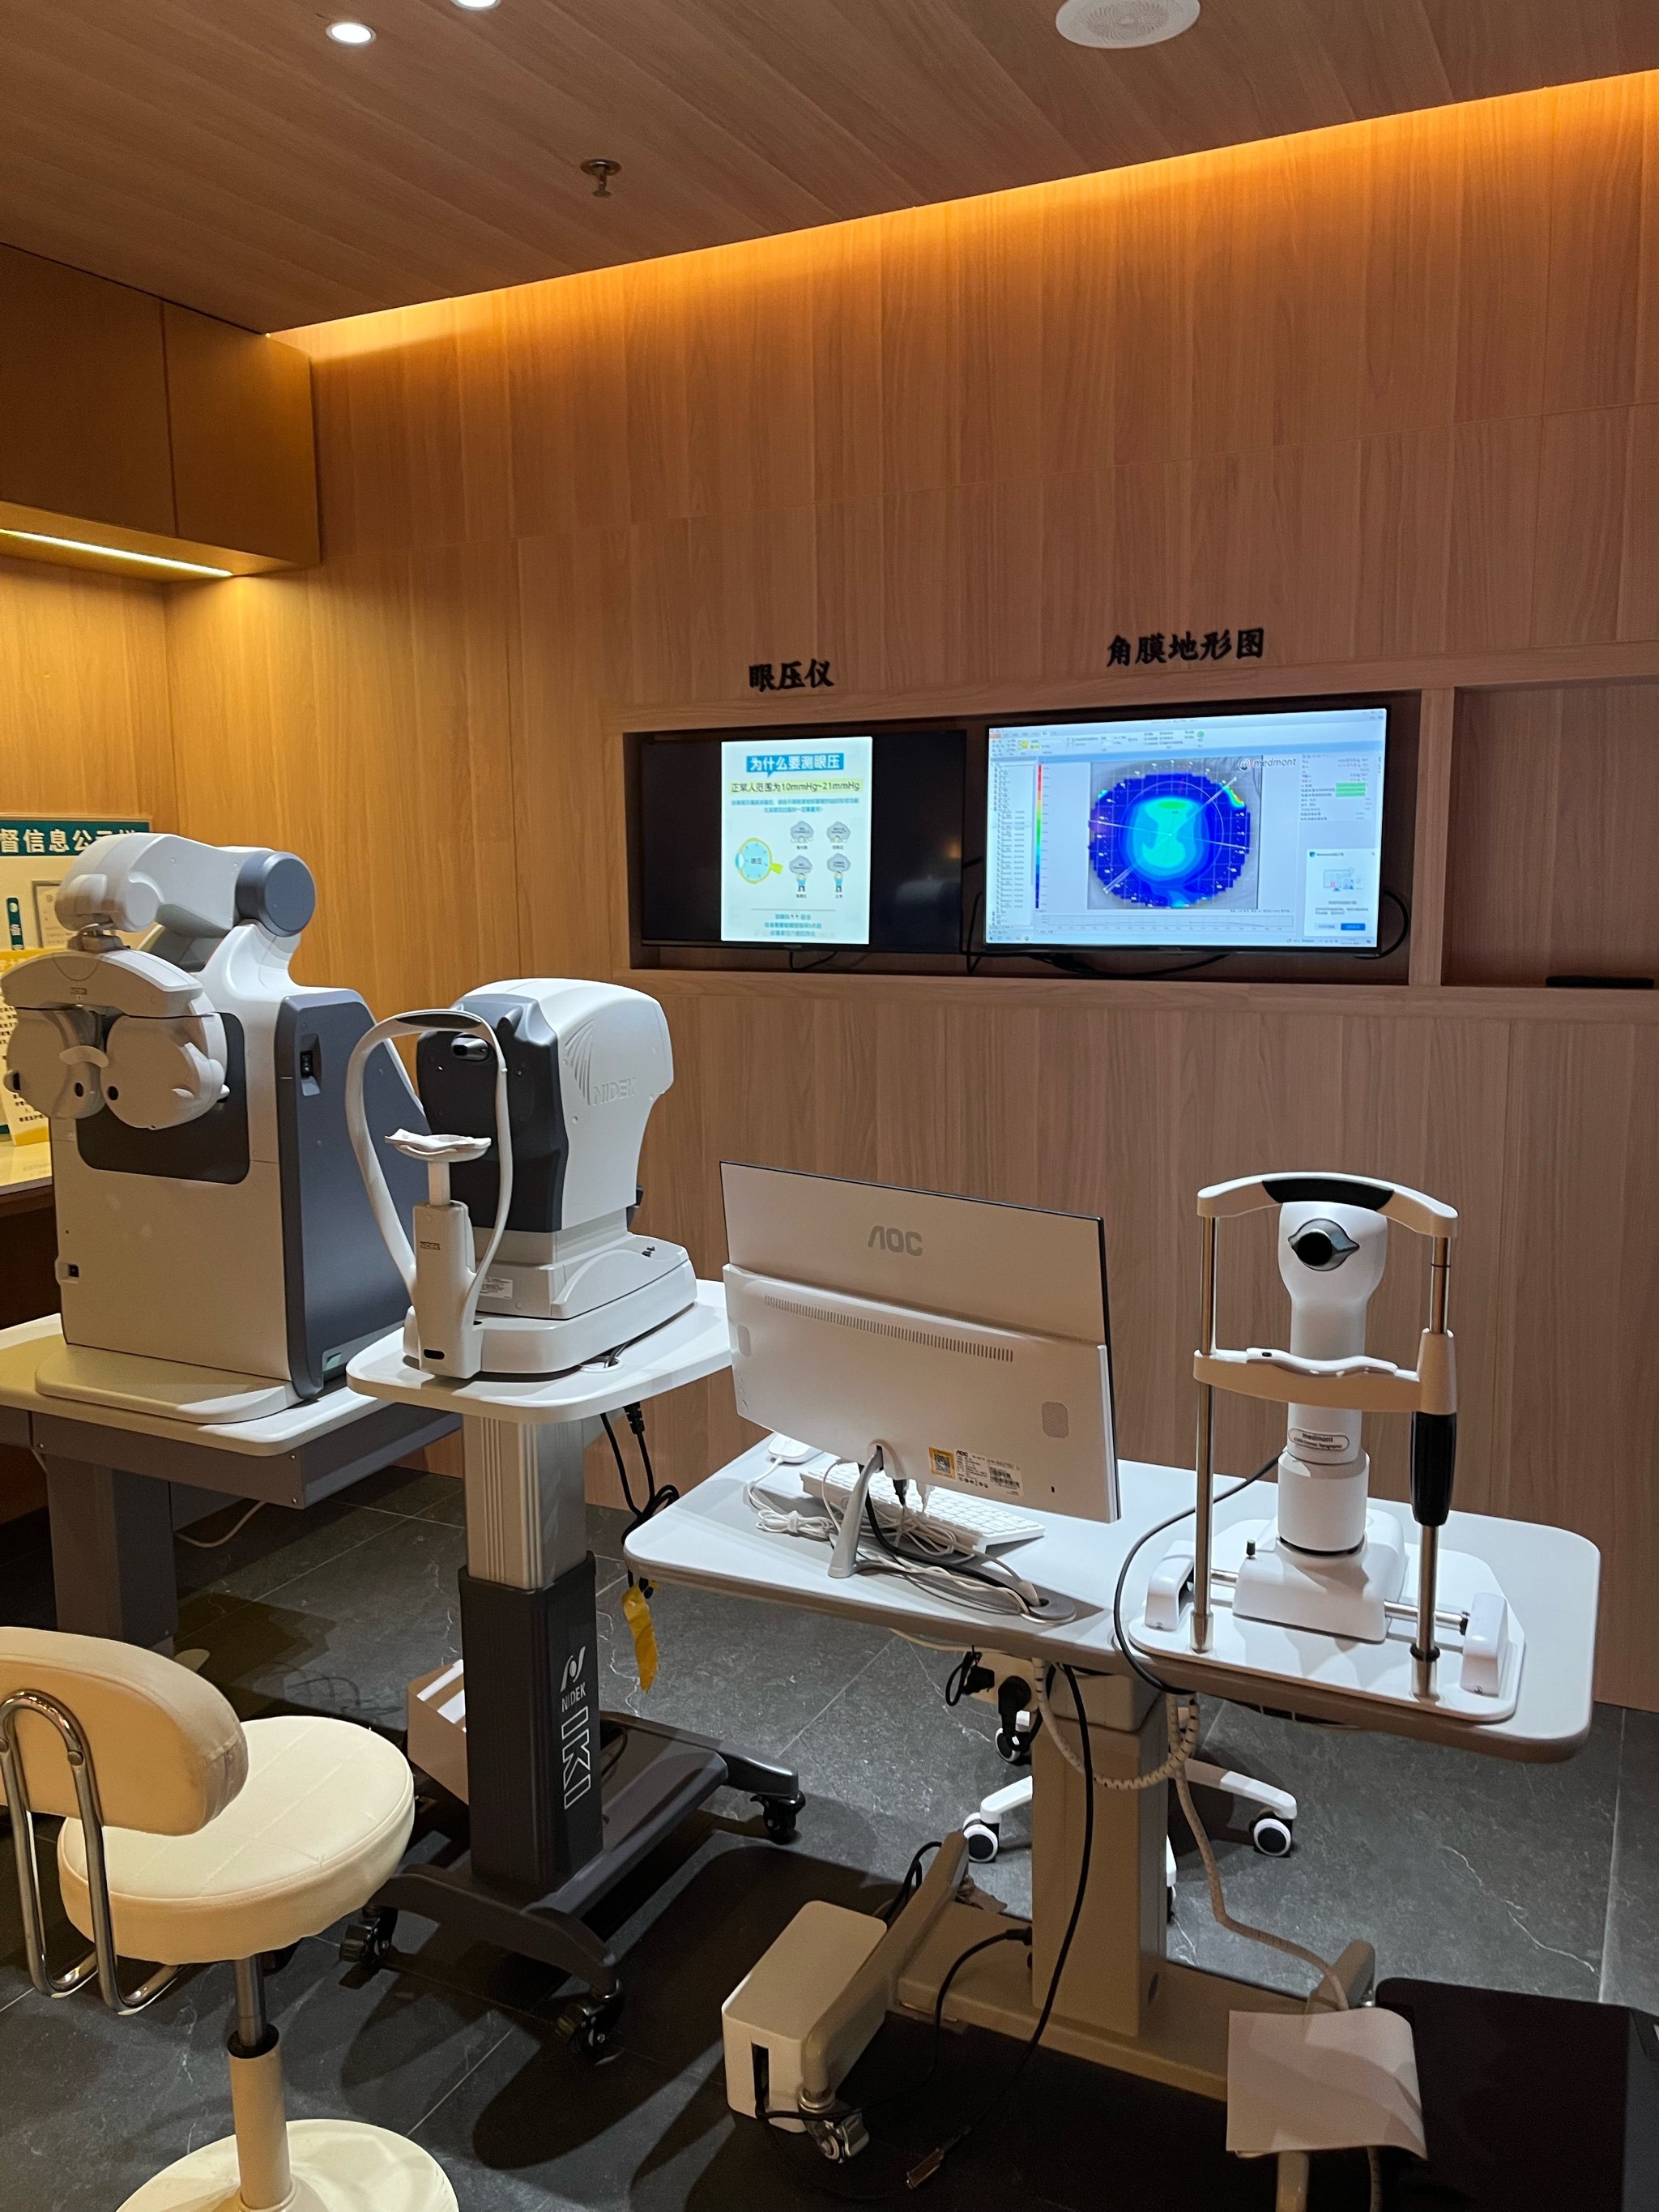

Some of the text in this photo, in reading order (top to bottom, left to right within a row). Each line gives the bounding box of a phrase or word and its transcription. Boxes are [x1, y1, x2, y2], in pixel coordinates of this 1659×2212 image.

[1107, 627, 1265, 668] 角膜地形图
[748, 659, 834, 693] 眼压仪
[750, 754, 840, 771] 为什么要测眼压
[1253, 758, 1297, 767] medmont
[868, 1225, 923, 1257] AOC
[561, 1681, 586, 1713] NIDEK
